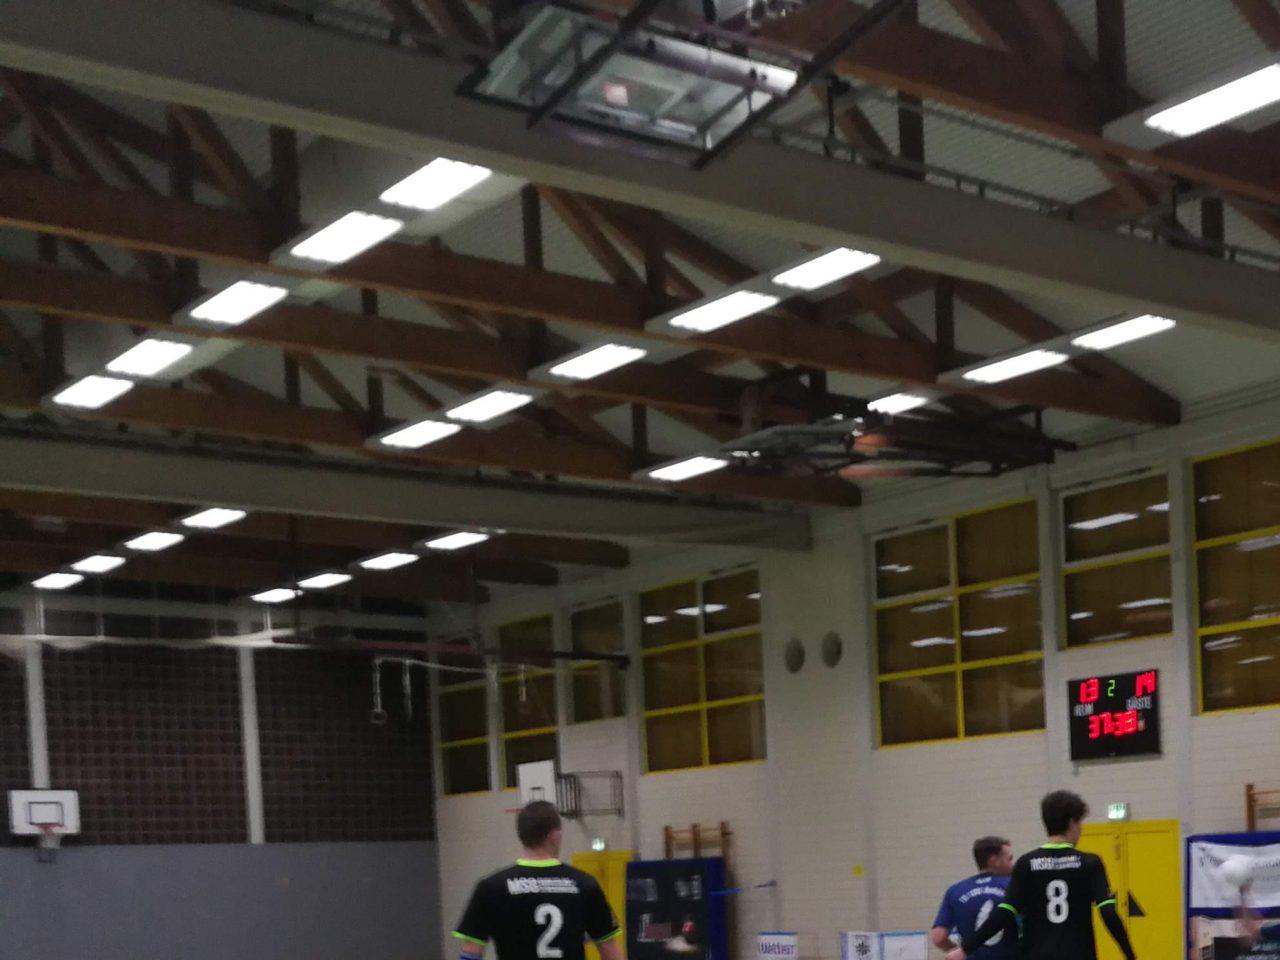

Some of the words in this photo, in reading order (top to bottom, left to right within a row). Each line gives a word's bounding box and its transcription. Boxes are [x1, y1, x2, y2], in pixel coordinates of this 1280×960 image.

[1107, 679, 1116, 696] 2
[1046, 879, 1069, 924] 8
[534, 903, 564, 959] 2
